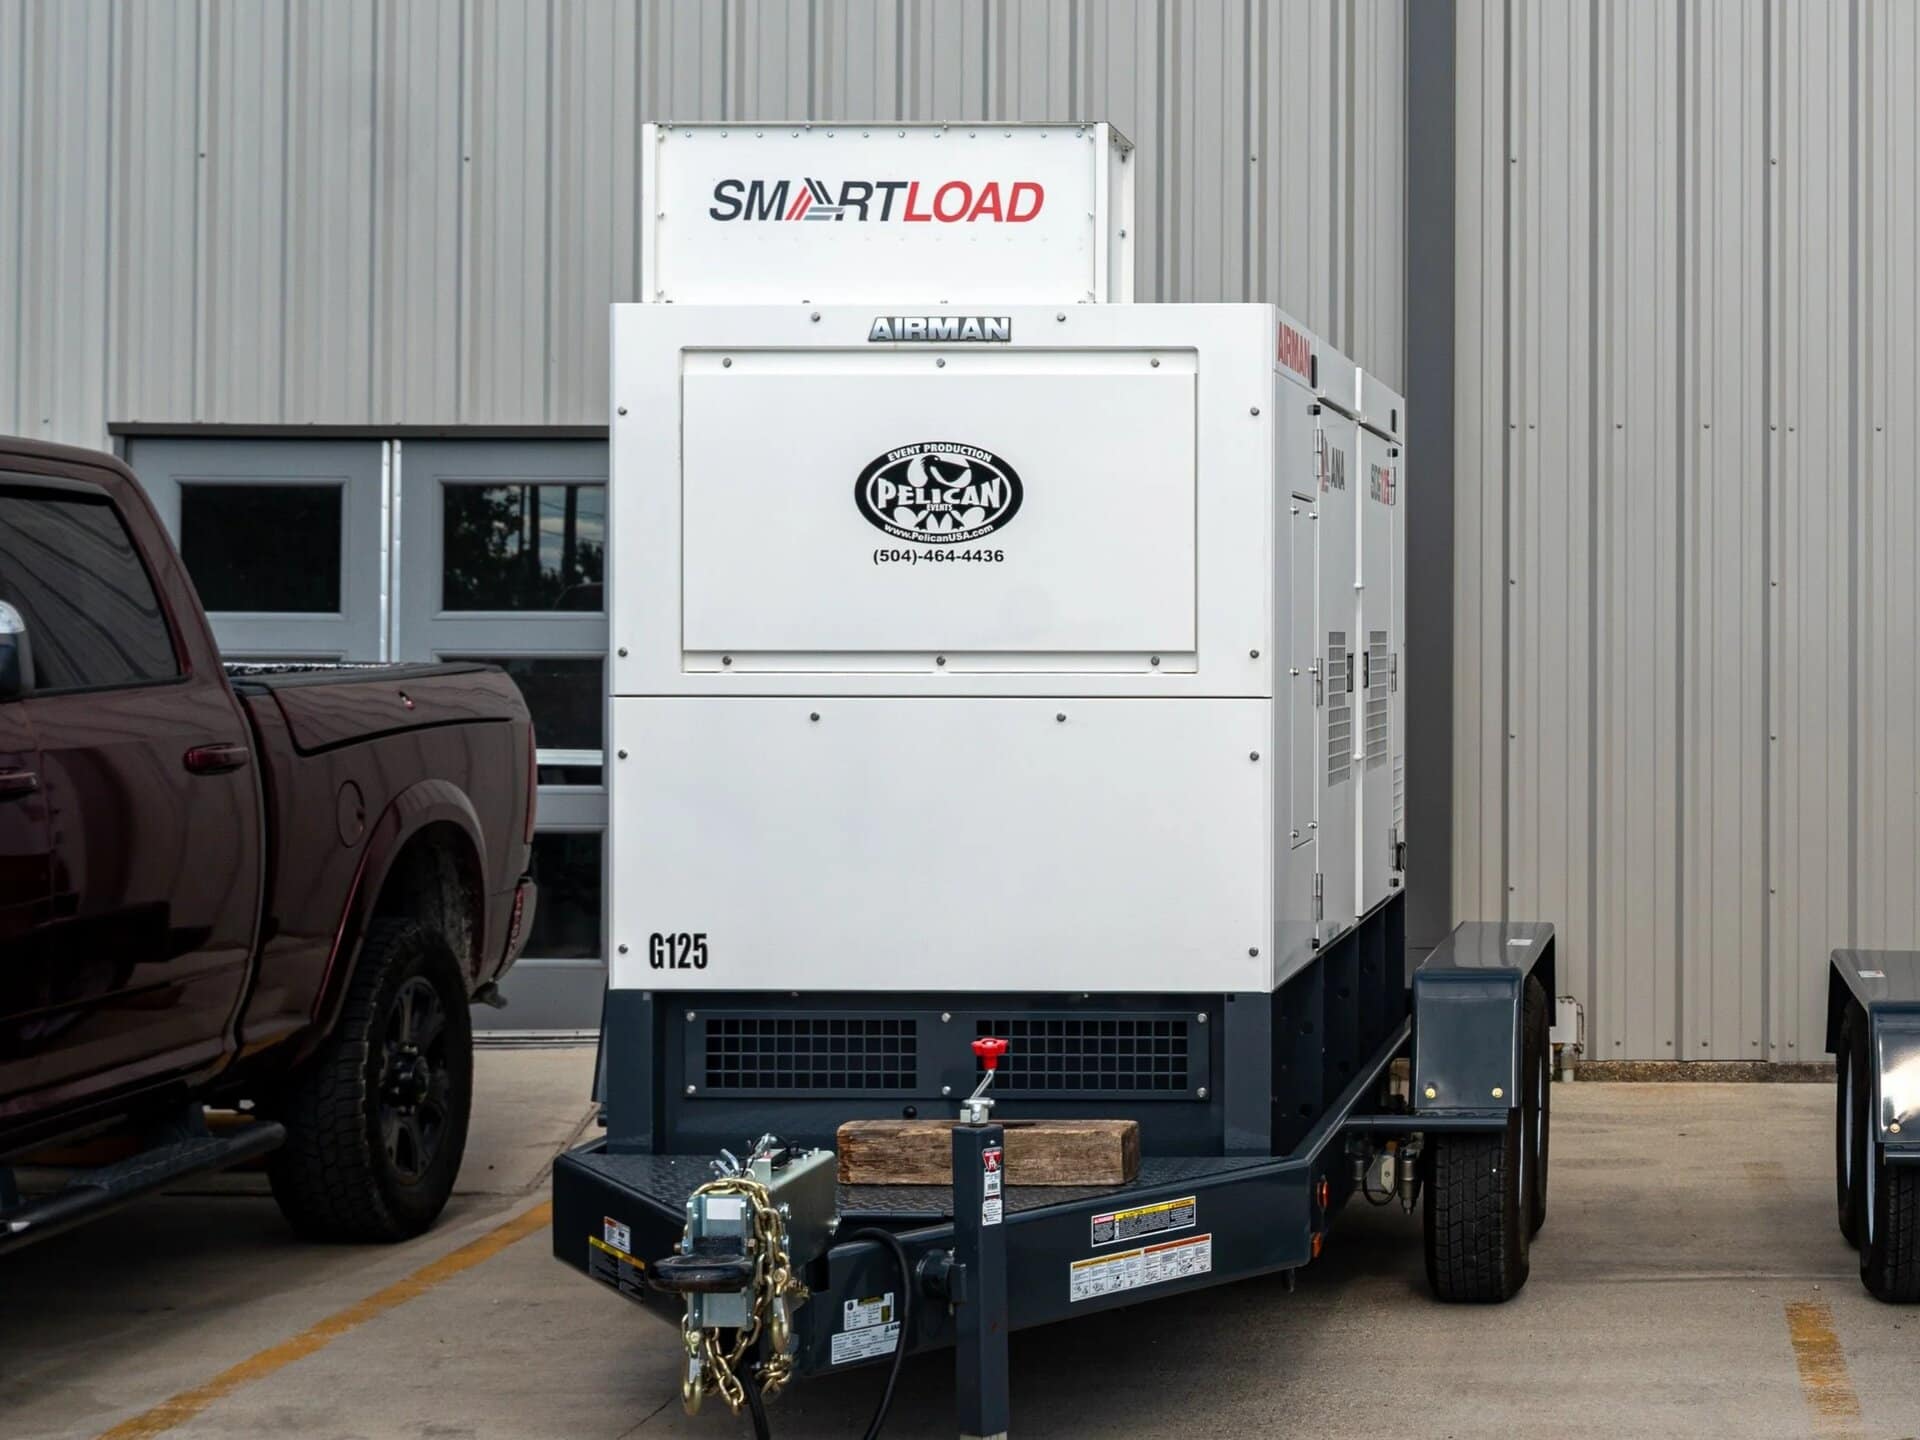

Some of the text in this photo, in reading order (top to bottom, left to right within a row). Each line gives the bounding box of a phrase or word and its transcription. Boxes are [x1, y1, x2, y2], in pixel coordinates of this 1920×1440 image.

[709, 177, 1045, 223] SMARTLOAD
[868, 317, 1012, 342] AIRMAN
[887, 442, 993, 463] EVENT PRODUCTION
[877, 476, 1001, 510] PELICAN
[926, 504, 953, 512] EVENTS
[884, 523, 994, 543] www.PelicanUSA.com
[873, 549, 1005, 566] (504)-464-4436
[649, 932, 708, 969] G125
